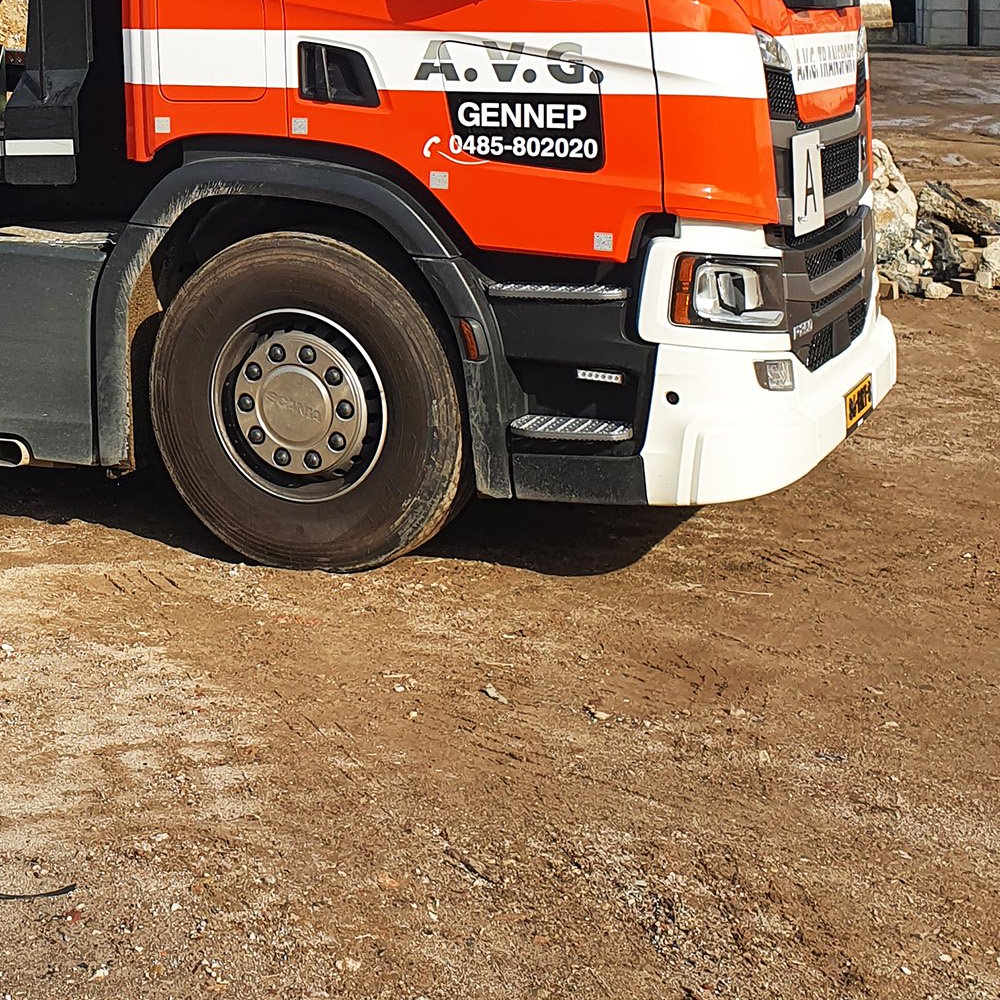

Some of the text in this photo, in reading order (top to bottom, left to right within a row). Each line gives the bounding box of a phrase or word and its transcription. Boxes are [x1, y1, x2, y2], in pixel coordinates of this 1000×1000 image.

[413, 39, 605, 85] A.V.G.
[457, 101, 588, 130] GENNEP
[448, 134, 599, 159] 0485-802020
[803, 148, 818, 217] A
[264, 390, 322, 424] SCANIA
